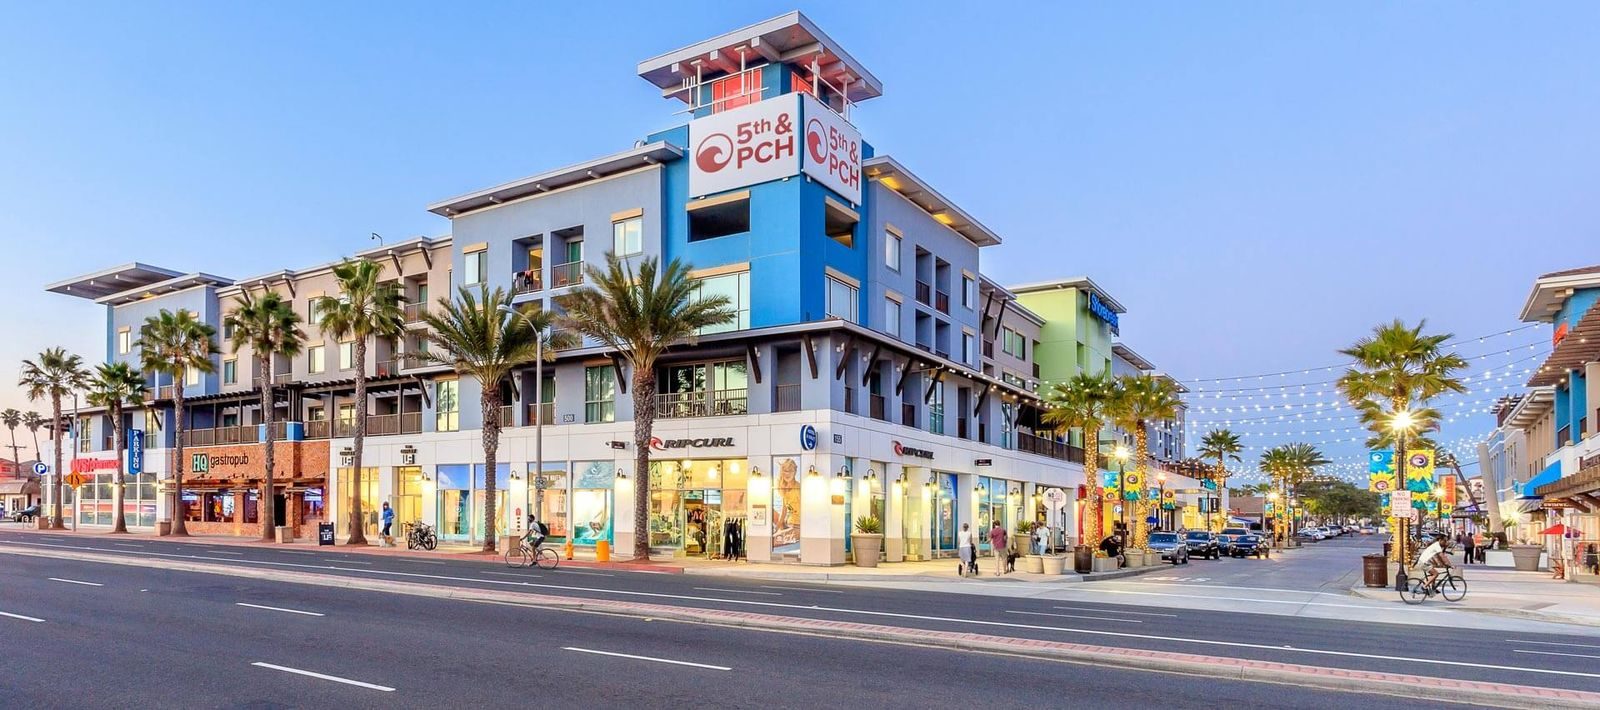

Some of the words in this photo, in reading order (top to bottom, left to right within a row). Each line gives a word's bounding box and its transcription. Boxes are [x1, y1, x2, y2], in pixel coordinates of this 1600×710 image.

[737, 118, 771, 144] 5th
[774, 112, 793, 135] &
[737, 135, 794, 169] PCH
[829, 125, 848, 152] 5th
[849, 141, 859, 165] &
[829, 154, 859, 191] PCH
[192, 454, 208, 473] HQ
[210, 452, 249, 469] gastropub
